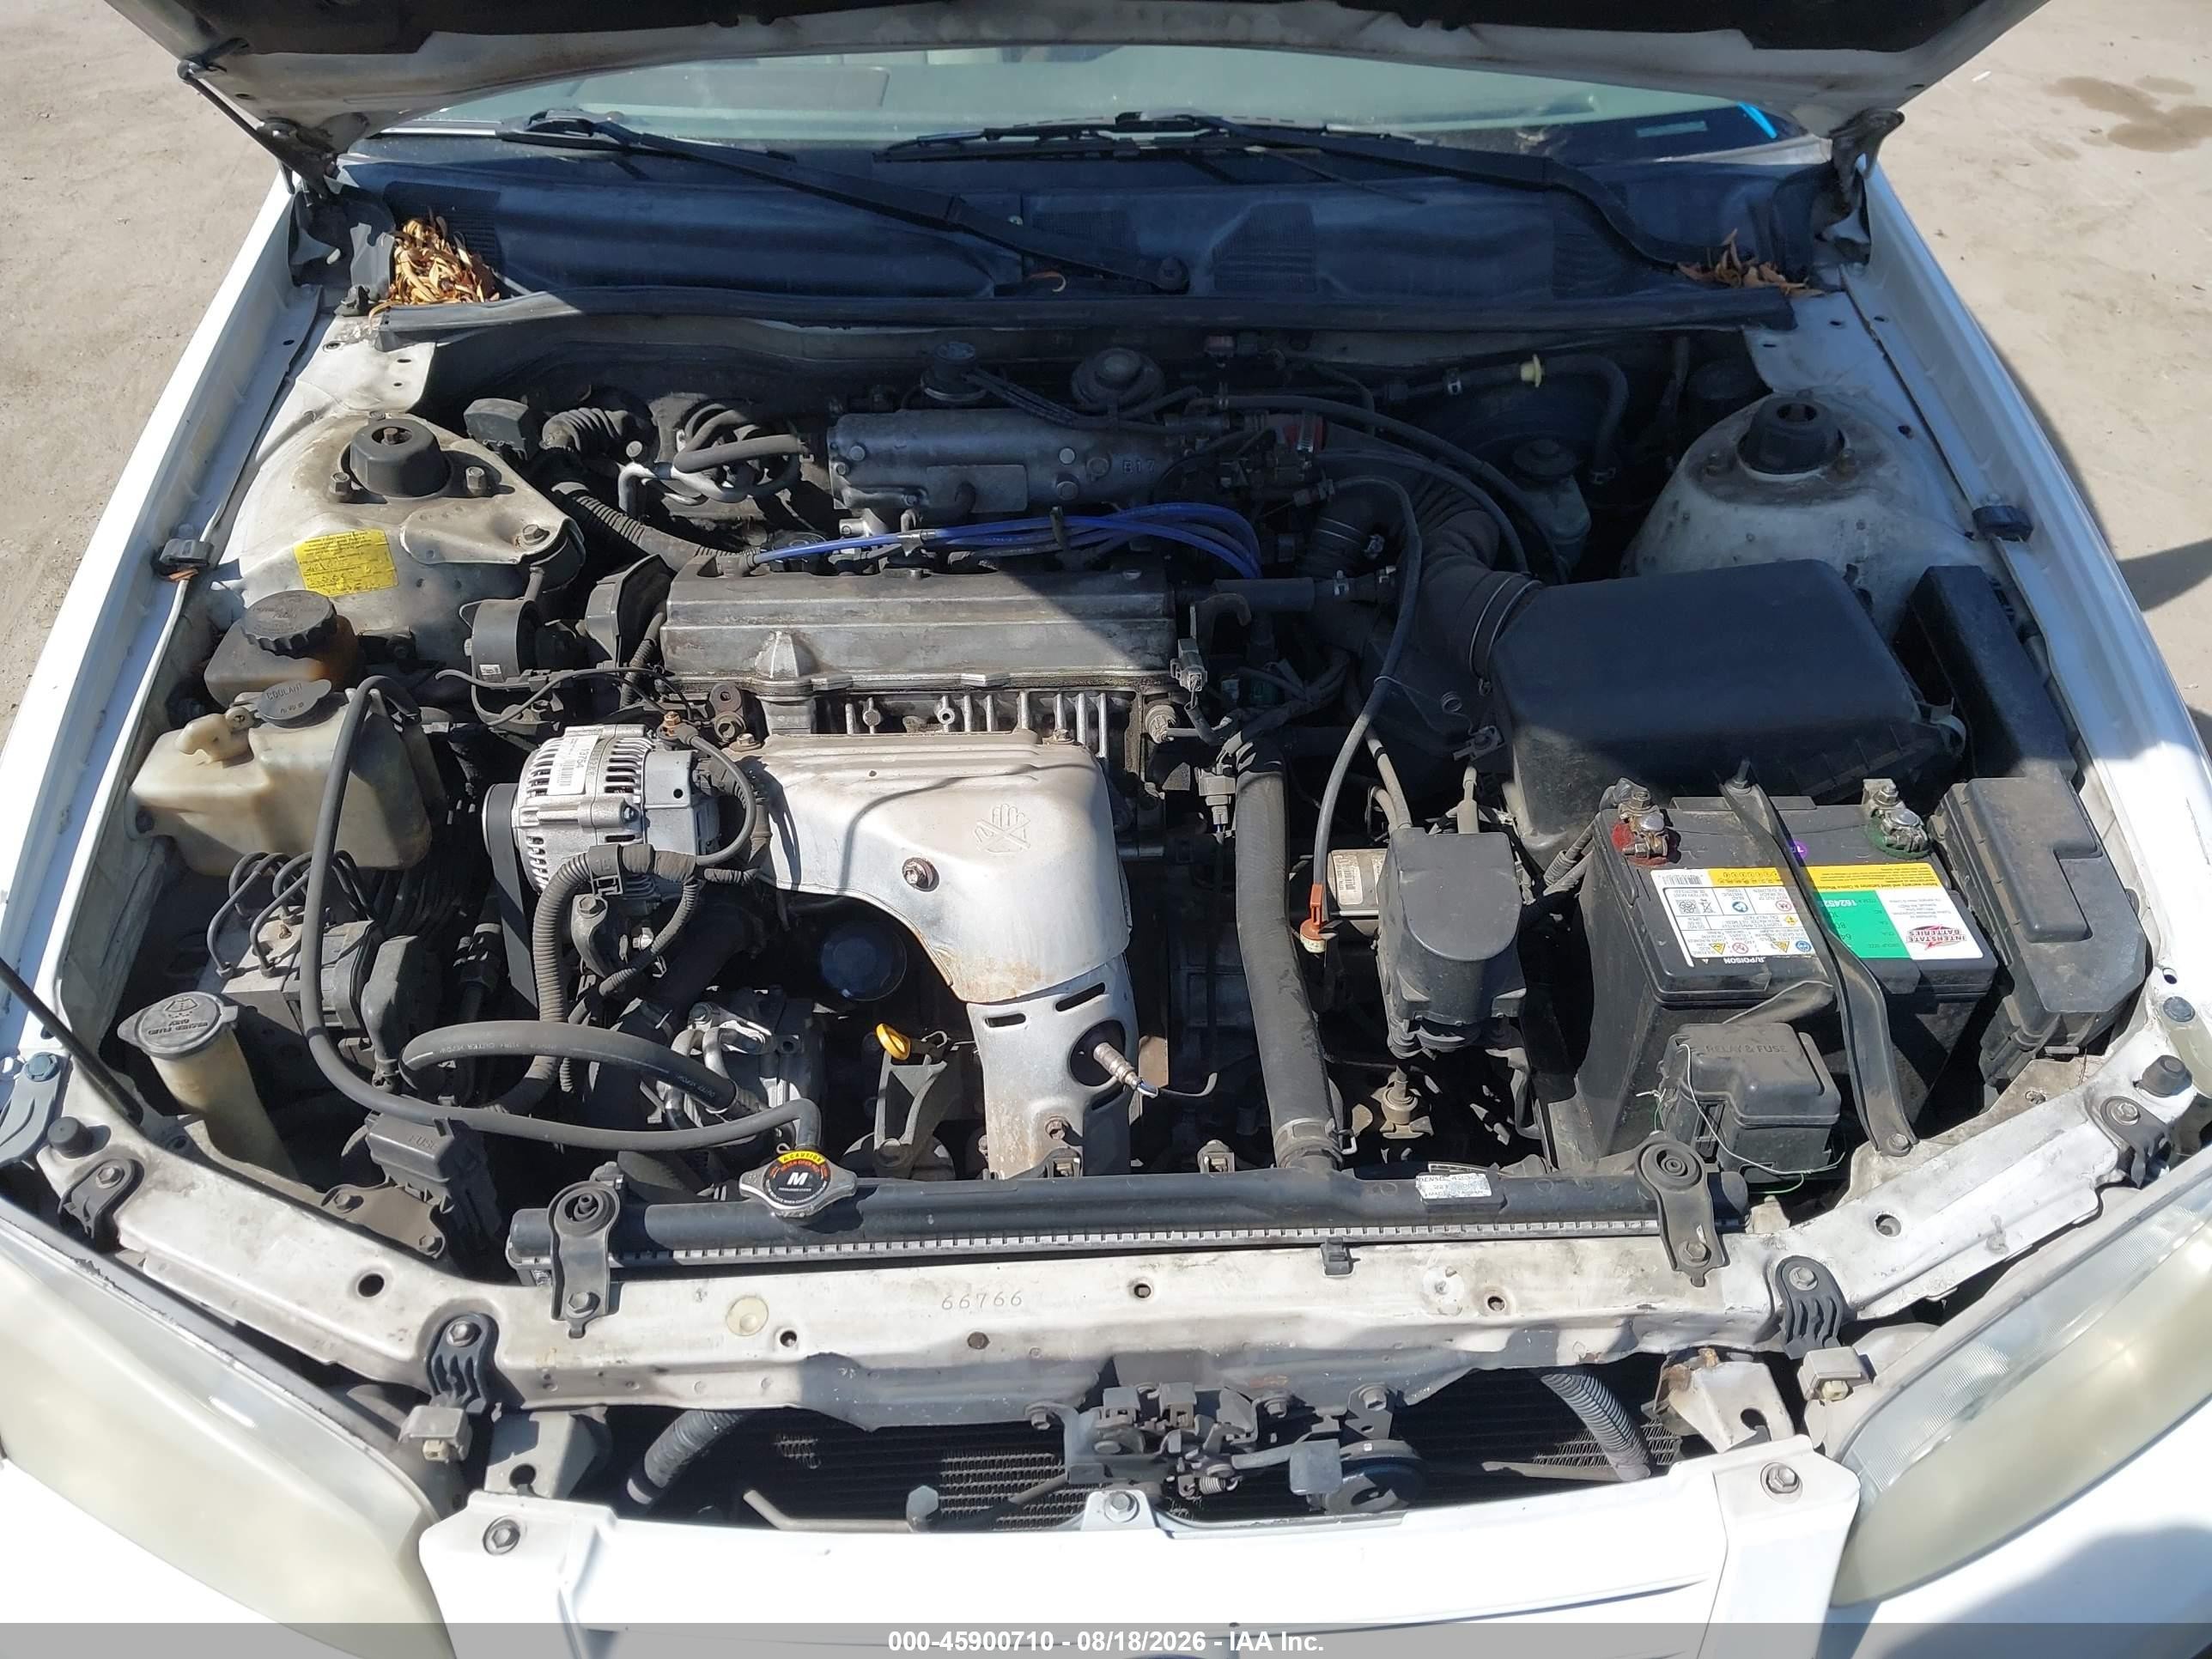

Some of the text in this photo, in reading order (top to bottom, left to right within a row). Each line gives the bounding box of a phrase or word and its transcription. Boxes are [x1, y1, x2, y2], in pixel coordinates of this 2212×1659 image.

[576, 748, 590, 769] 13754
[1745, 1044, 1755, 1053] &
[789, 1152, 823, 1163] CAUTION
[787, 1172, 809, 1186] M
[941, 1291, 1023, 1310] 66766
